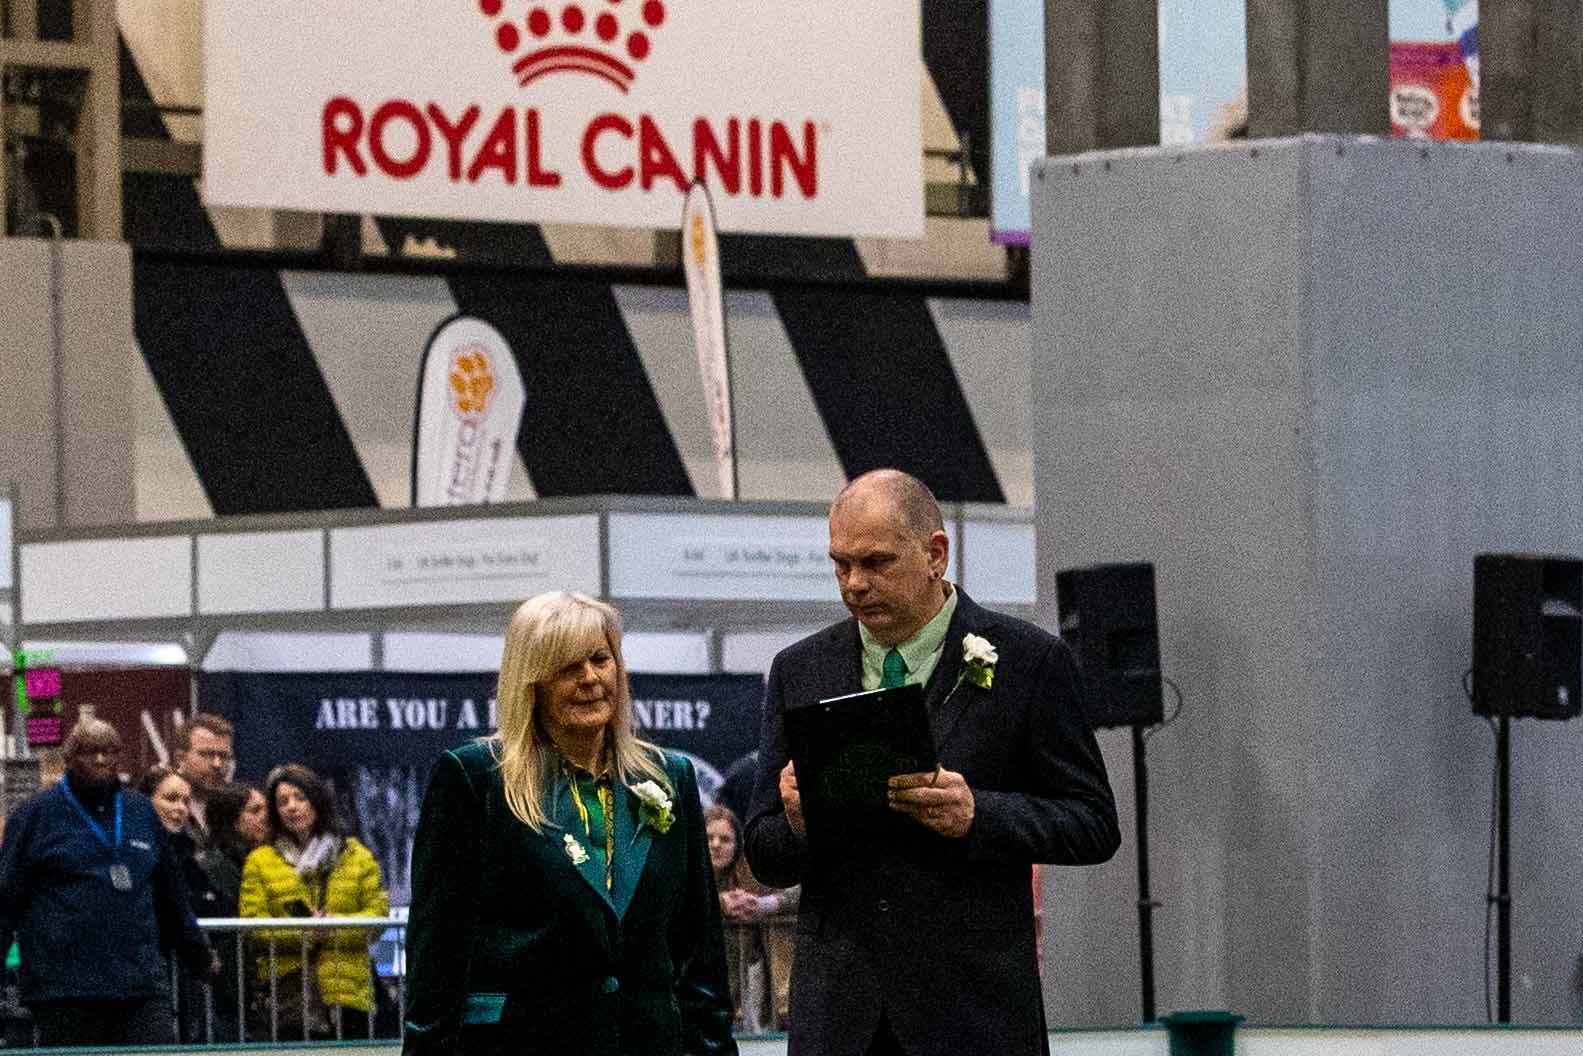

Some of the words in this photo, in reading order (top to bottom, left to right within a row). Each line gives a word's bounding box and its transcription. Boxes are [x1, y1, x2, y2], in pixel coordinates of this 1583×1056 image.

[321, 96, 561, 188] ROYAL
[580, 112, 818, 200] CANIN
[316, 698, 379, 730] ARE
[385, 698, 447, 730] YOU
[456, 698, 479, 729] A
